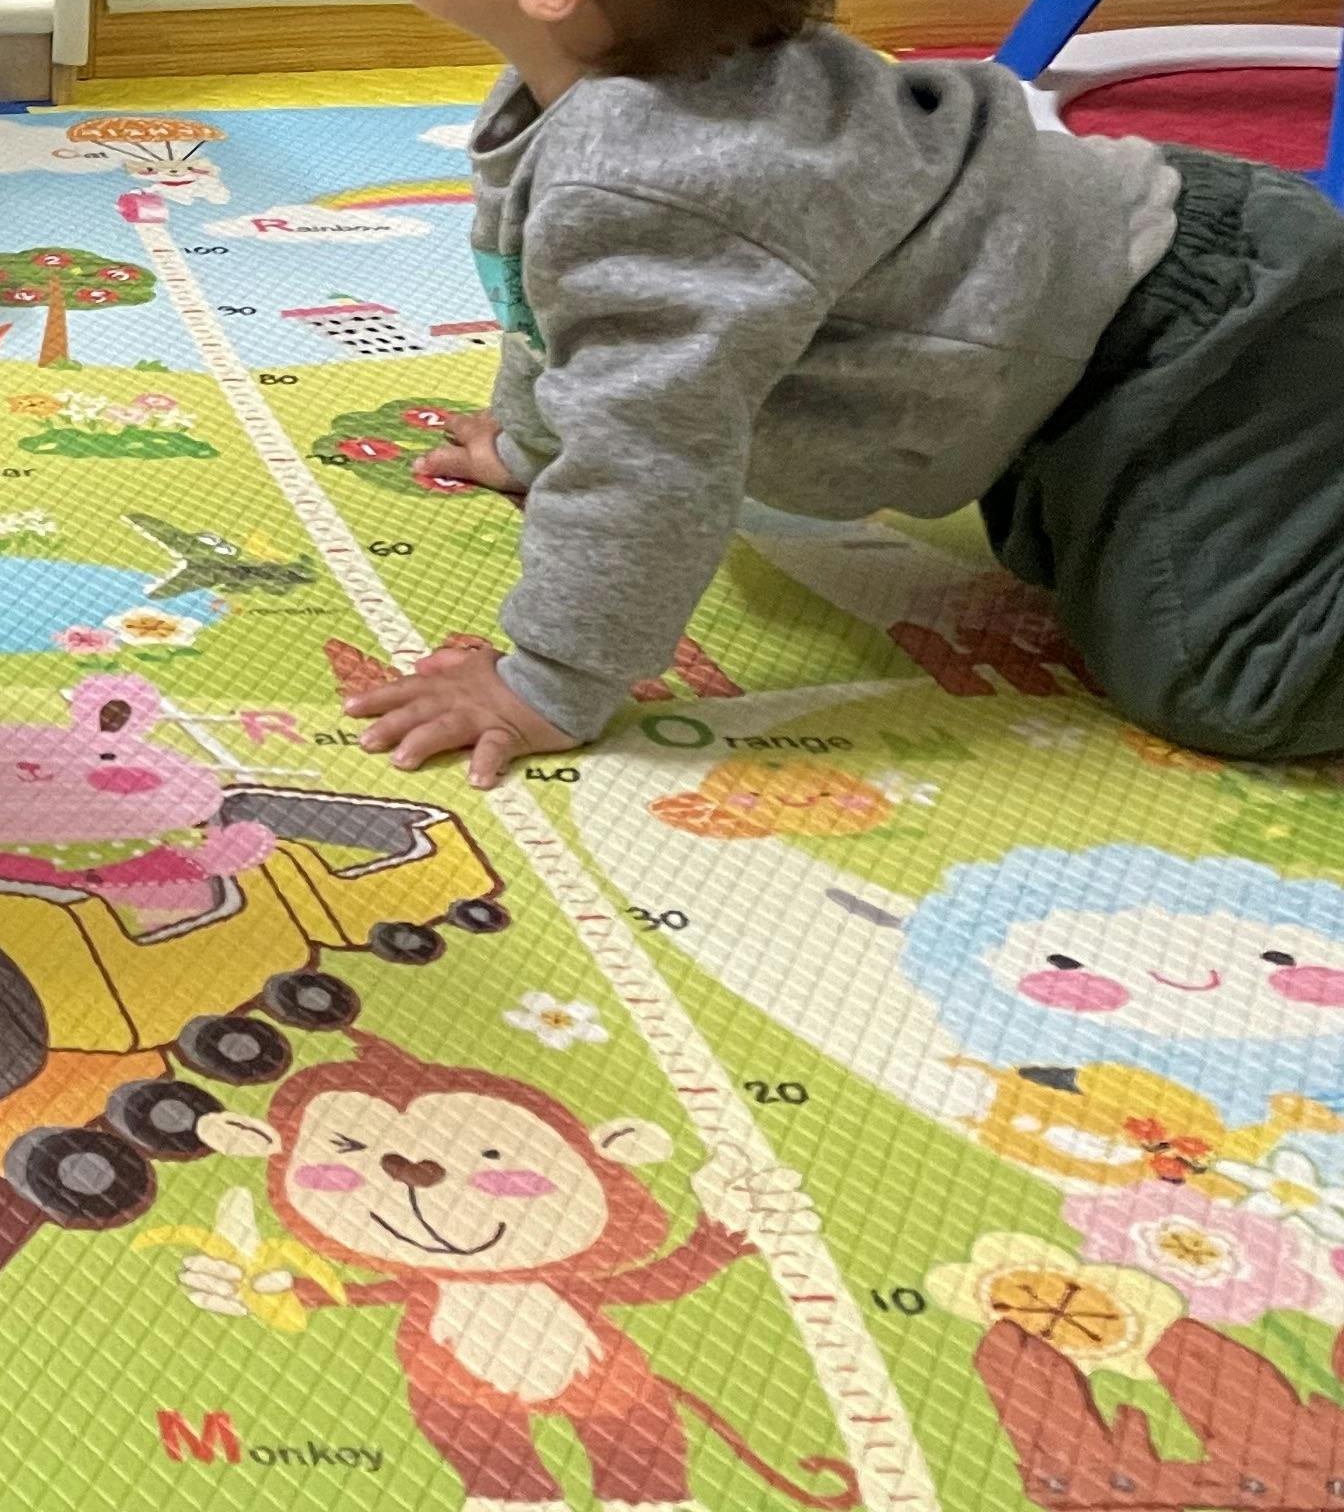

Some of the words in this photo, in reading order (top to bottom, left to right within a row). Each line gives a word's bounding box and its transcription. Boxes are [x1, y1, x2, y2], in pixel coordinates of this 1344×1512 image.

[251, 217, 392, 234] Rainbow
[182, 245, 229, 255] 100
[44, 254, 62, 266] 2
[105, 268, 130, 281] 3
[258, 373, 300, 386] 80
[418, 411, 447, 427] 2
[361, 443, 377, 456] 1
[368, 540, 415, 557] 60
[239, 711, 362, 746] Rab
[638, 714, 855, 753] Orange
[525, 767, 581, 783] 40
[626, 906, 689, 930] 30
[744, 1080, 810, 1105] 20
[871, 1287, 927, 1316] 10
[157, 1409, 384, 1472] Monkey
